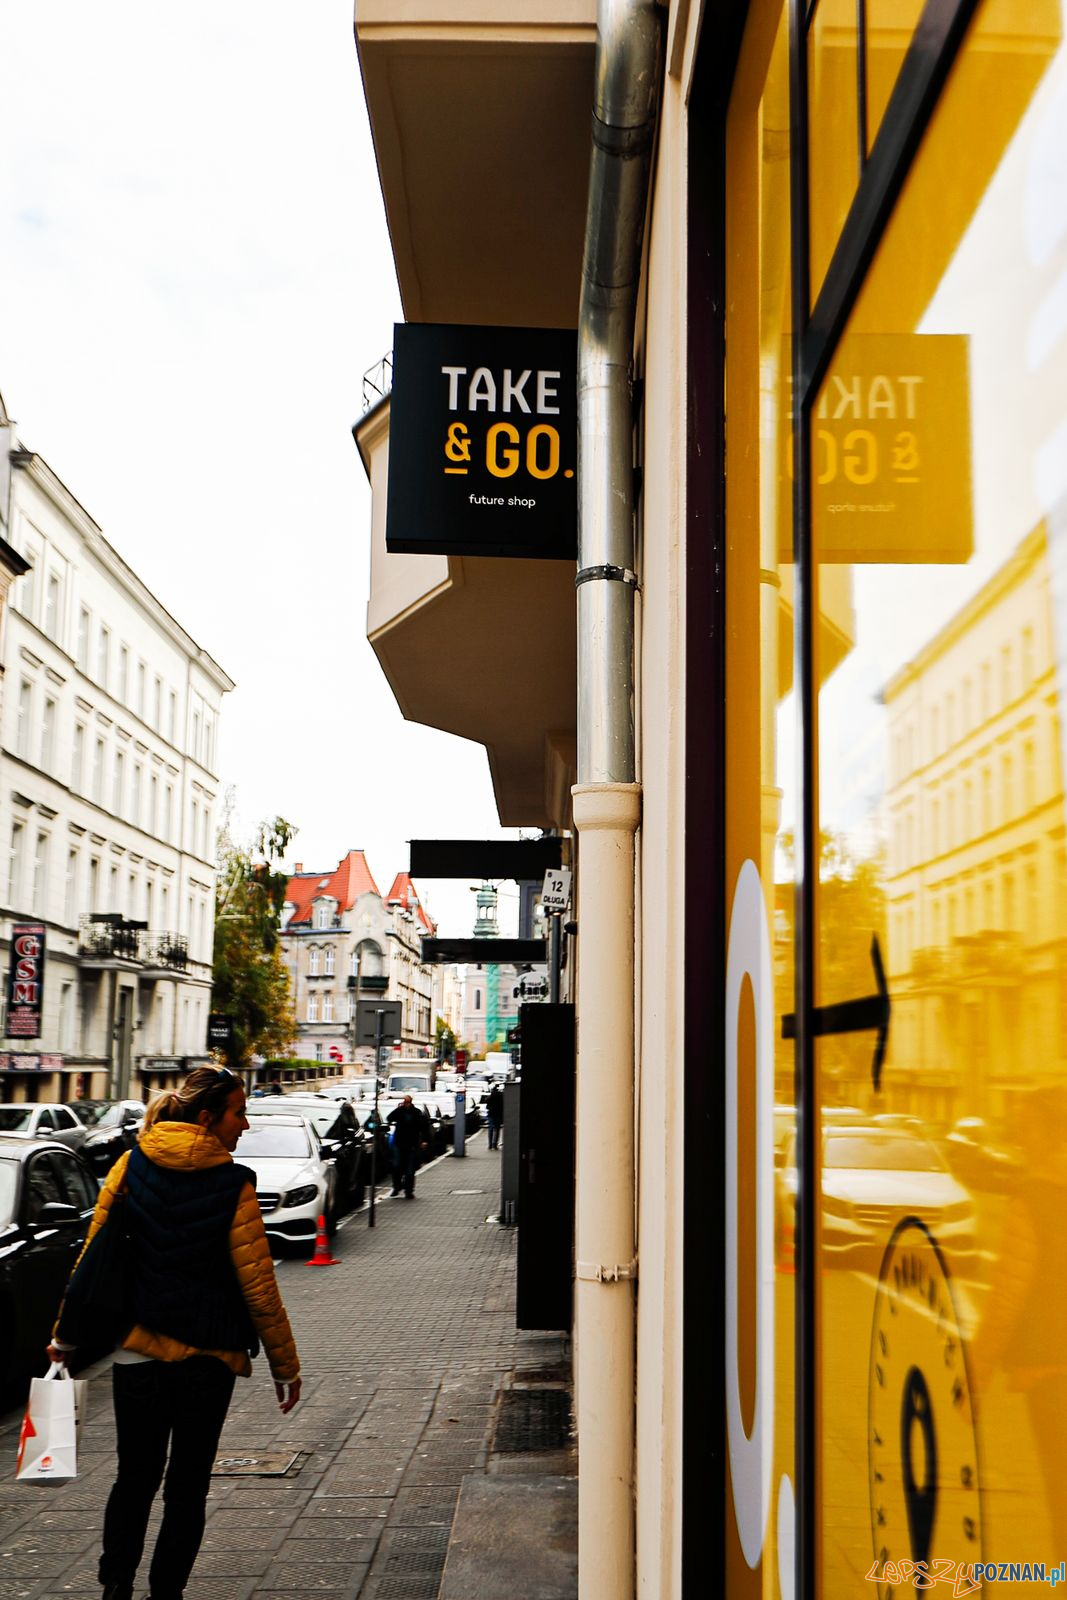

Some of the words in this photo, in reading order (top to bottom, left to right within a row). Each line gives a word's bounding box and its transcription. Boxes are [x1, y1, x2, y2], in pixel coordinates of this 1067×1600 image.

[441, 366, 561, 415] TAKE
[444, 422, 472, 475] &
[486, 422, 574, 480] GO.
[469, 493, 505, 506] future
[507, 495, 536, 509] shop
[551, 880, 564, 892] 12
[12, 935, 41, 1005] GSM
